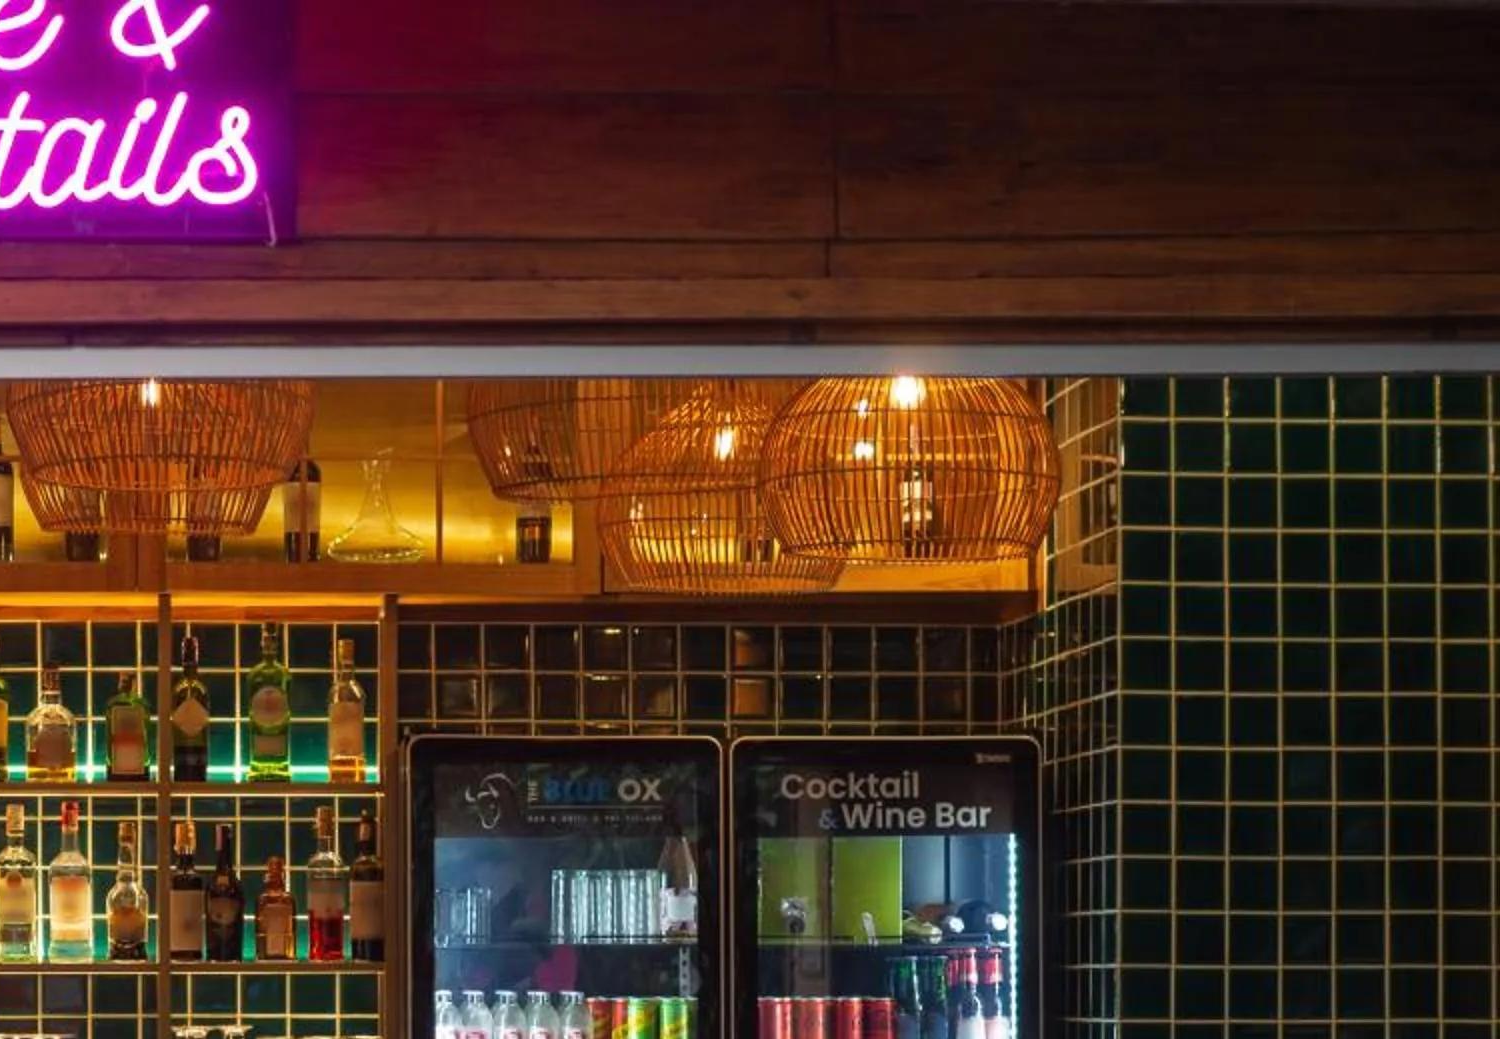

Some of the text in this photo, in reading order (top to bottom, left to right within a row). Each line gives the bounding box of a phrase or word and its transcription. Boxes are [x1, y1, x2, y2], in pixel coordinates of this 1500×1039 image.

[617, 778, 663, 802] OX
[780, 770, 920, 800] Cocktail
[818, 801, 993, 830] & Wine Bar
